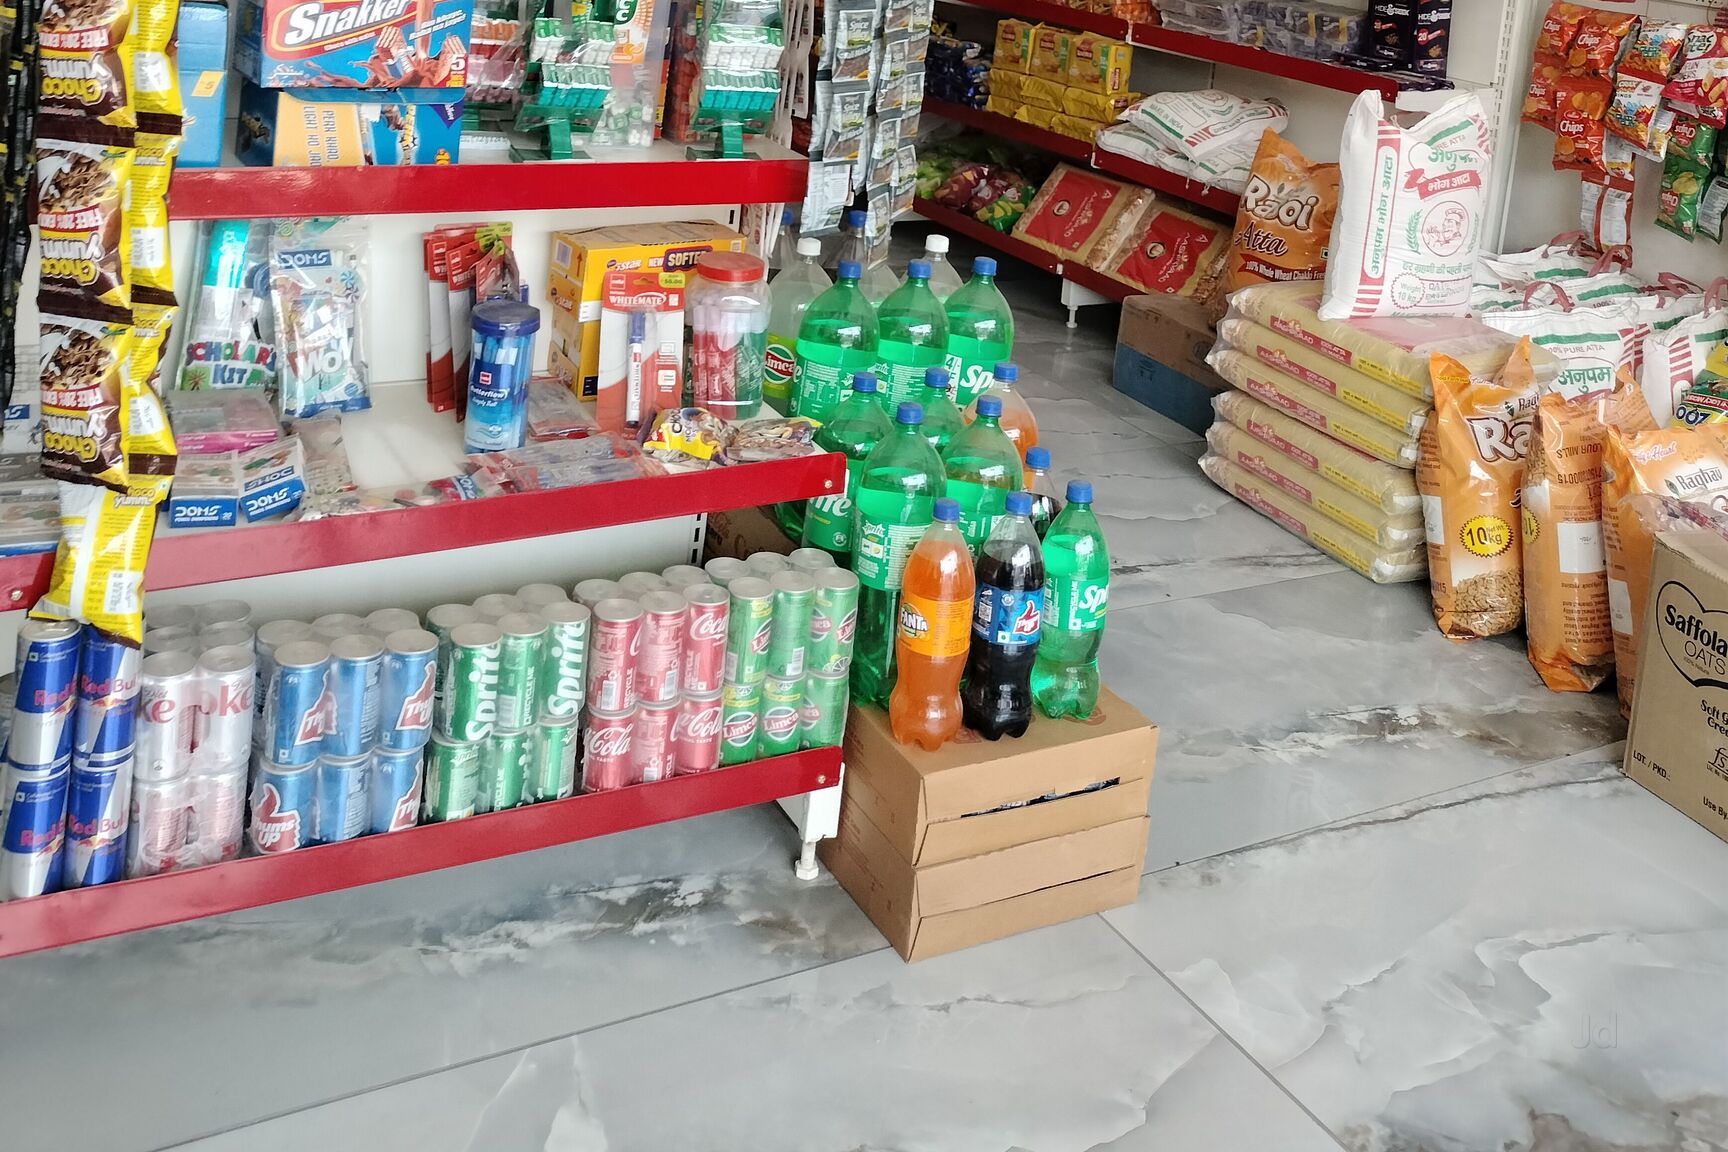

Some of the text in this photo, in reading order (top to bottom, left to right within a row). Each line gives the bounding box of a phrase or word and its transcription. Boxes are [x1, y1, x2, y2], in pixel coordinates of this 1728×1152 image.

[81, 28, 109, 47] FREE
[1577, 34, 1600, 46] Chips
[451, 55, 466, 71] 5
[42, 77, 103, 103] Choco
[1559, 120, 1584, 133] Chips
[1235, 222, 1289, 257] Atta
[279, 251, 329, 268] DOMS
[1275, 269, 1293, 280] Wheat
[609, 293, 666, 306] WHITEMATE
[1564, 344, 1605, 355] PURE ATTA
[212, 364, 247, 385] KIT
[1558, 367, 1613, 394] अनुपम
[44, 431, 97, 461] Choco
[1557, 445, 1580, 459] MILLS
[1676, 465, 1723, 491] Raghav
[246, 487, 290, 512] DOMS
[175, 505, 222, 518] DOMS
[1467, 526, 1503, 547] 10 kg
[901, 610, 928, 632] FANTA
[1664, 604, 1728, 658] Saffola
[1684, 640, 1727, 676] OATS
[114, 676, 139, 692] Bul
[1700, 699, 1720, 719] Soft
[1703, 796, 1717, 811] Use
